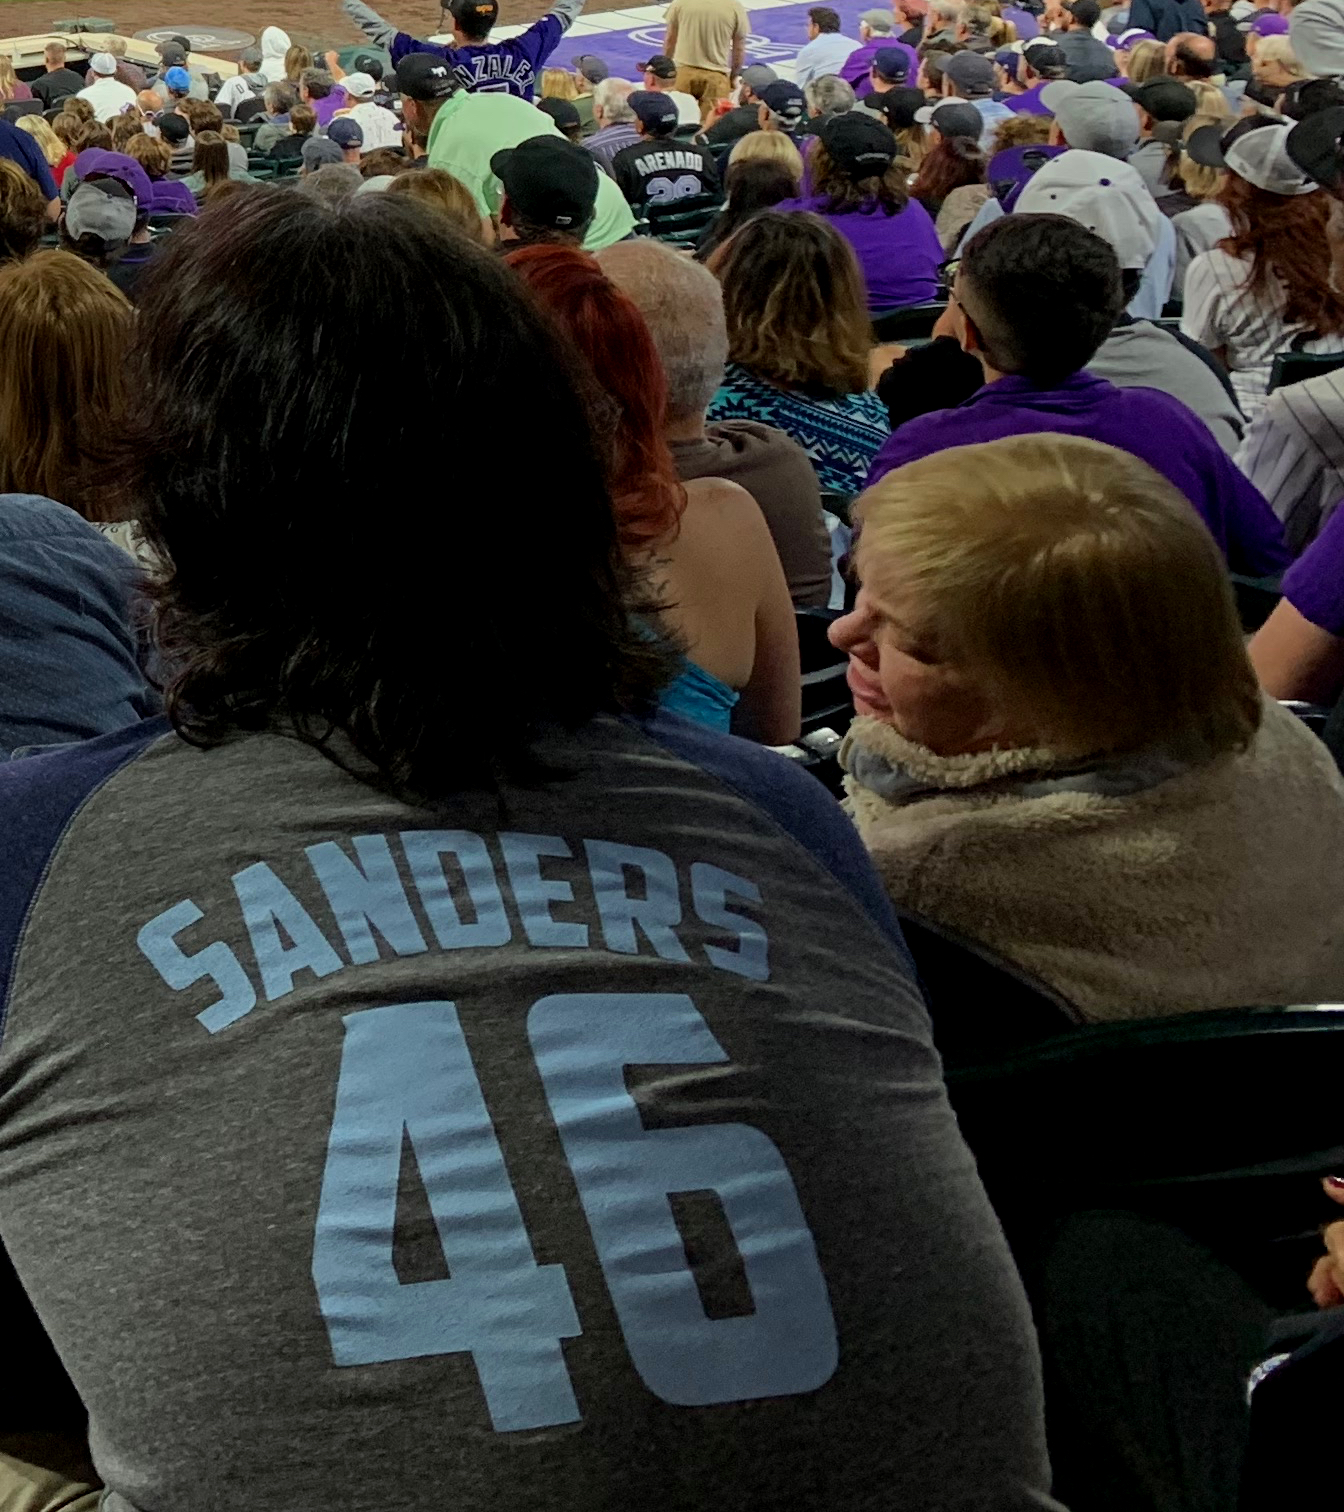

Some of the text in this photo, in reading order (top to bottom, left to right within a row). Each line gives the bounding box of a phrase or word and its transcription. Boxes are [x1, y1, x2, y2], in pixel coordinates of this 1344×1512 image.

[453, 54, 535, 95] NZALEZ
[633, 151, 704, 176] ARENADO
[646, 175, 702, 203] 28
[137, 830, 770, 1034] SANDERS
[312, 992, 840, 1433] 46
